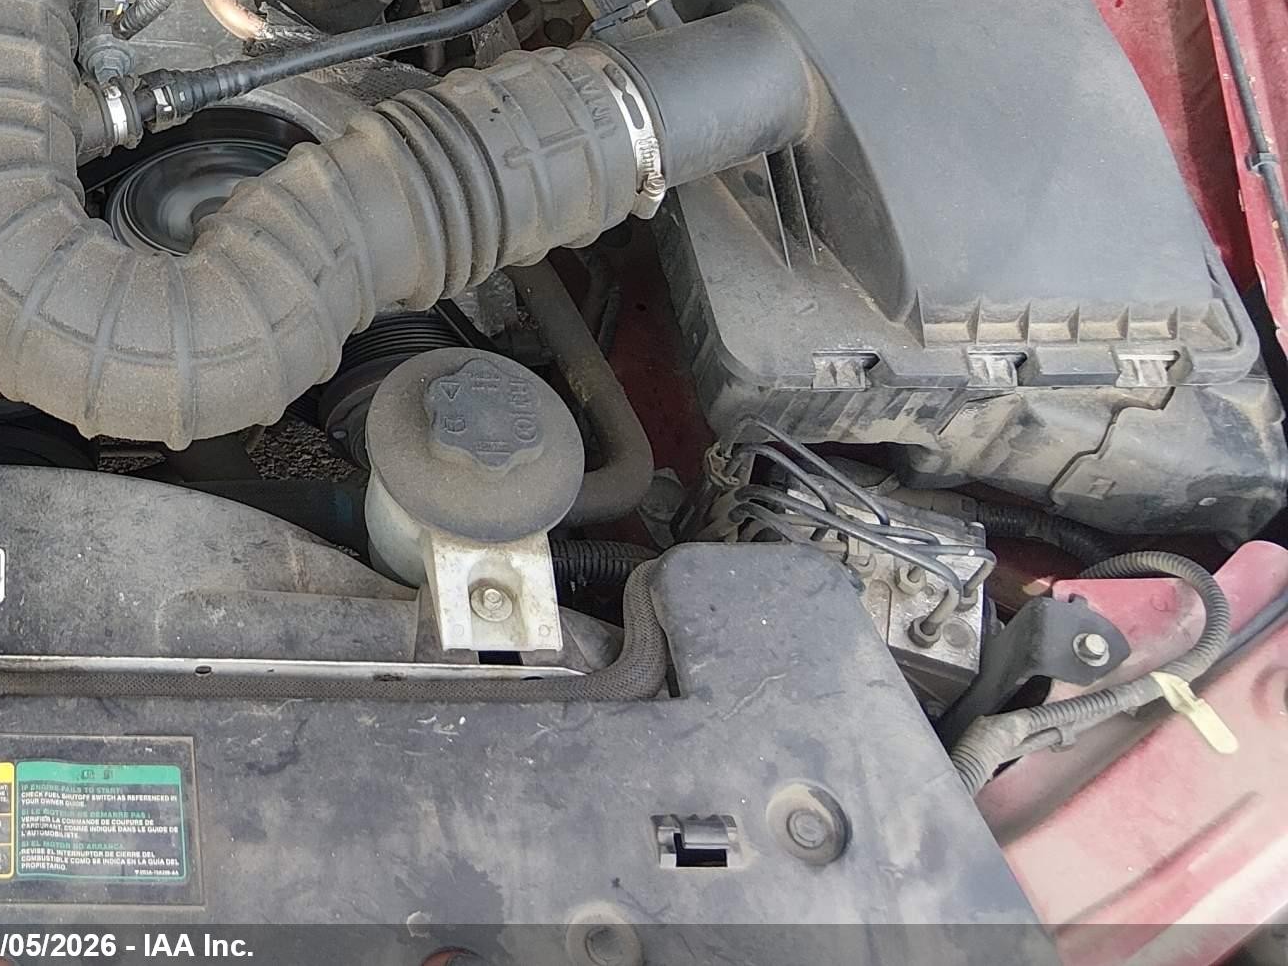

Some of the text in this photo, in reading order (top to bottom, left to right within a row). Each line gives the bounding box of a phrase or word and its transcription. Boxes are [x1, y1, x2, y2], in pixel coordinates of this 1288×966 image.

[61, 785, 81, 793] FAILS
[61, 793, 90, 801] SHUTOFF
[56, 849, 103, 857] INTERRUPTOR
[21, 855, 68, 863] COMBUSTIBLE
[166, 858, 179, 866] DEL
[414, 874, 482, 885] Motorcraft
